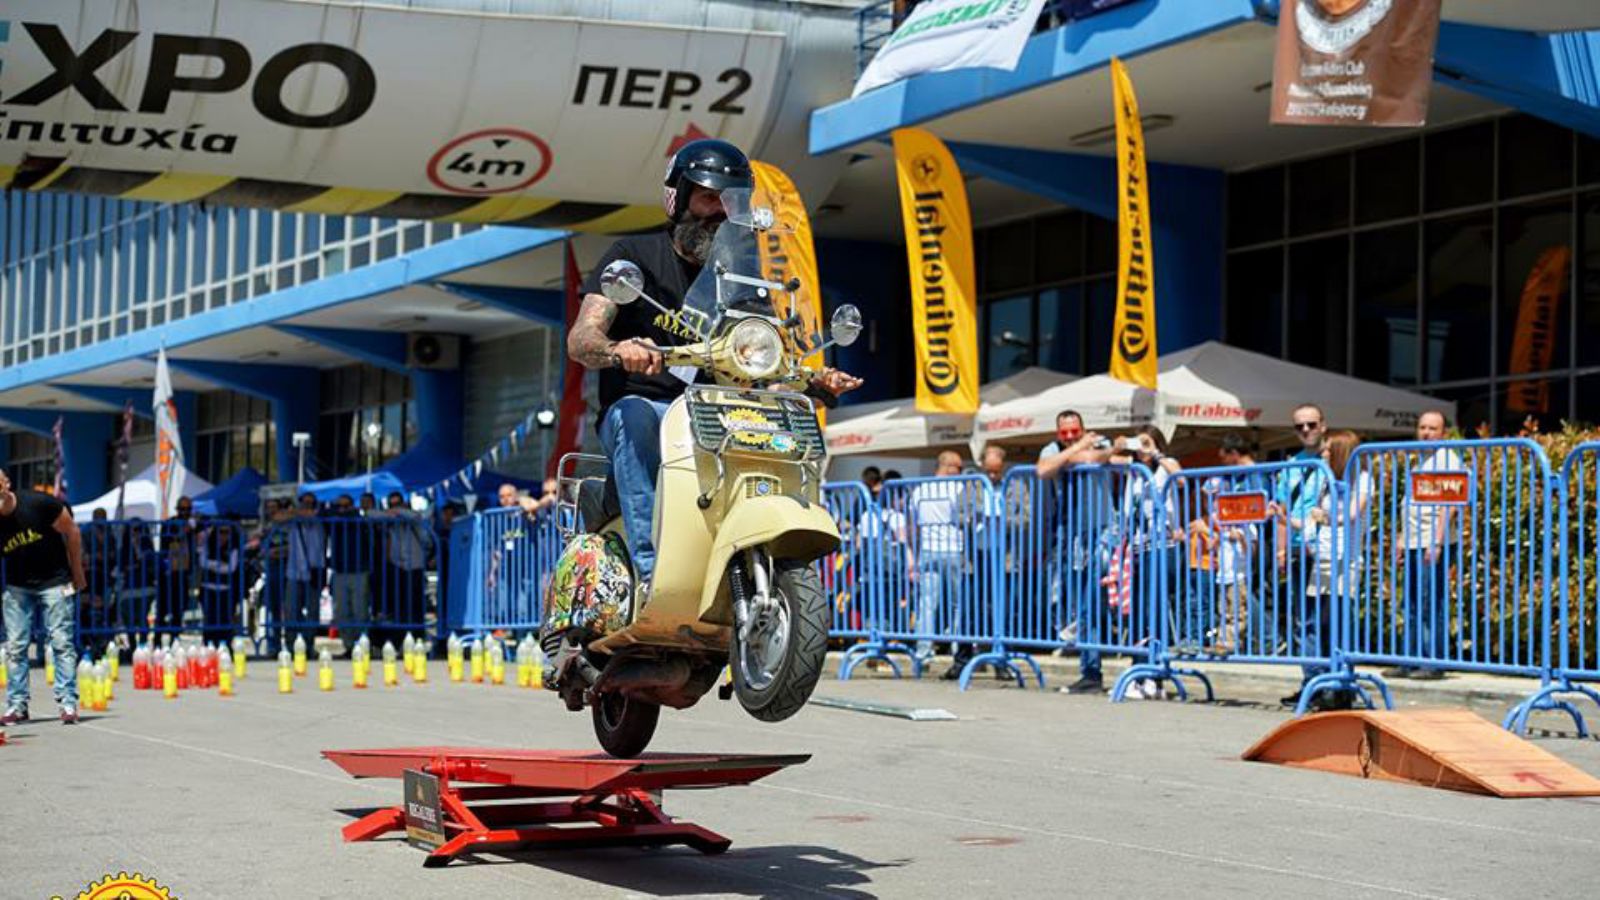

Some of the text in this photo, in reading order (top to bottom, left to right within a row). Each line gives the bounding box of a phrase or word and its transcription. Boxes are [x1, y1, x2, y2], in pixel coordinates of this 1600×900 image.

[0, 20, 377, 129] XPO
[572, 64, 753, 115] ΠΕΡ. 2
[447, 152, 526, 177] 4m
